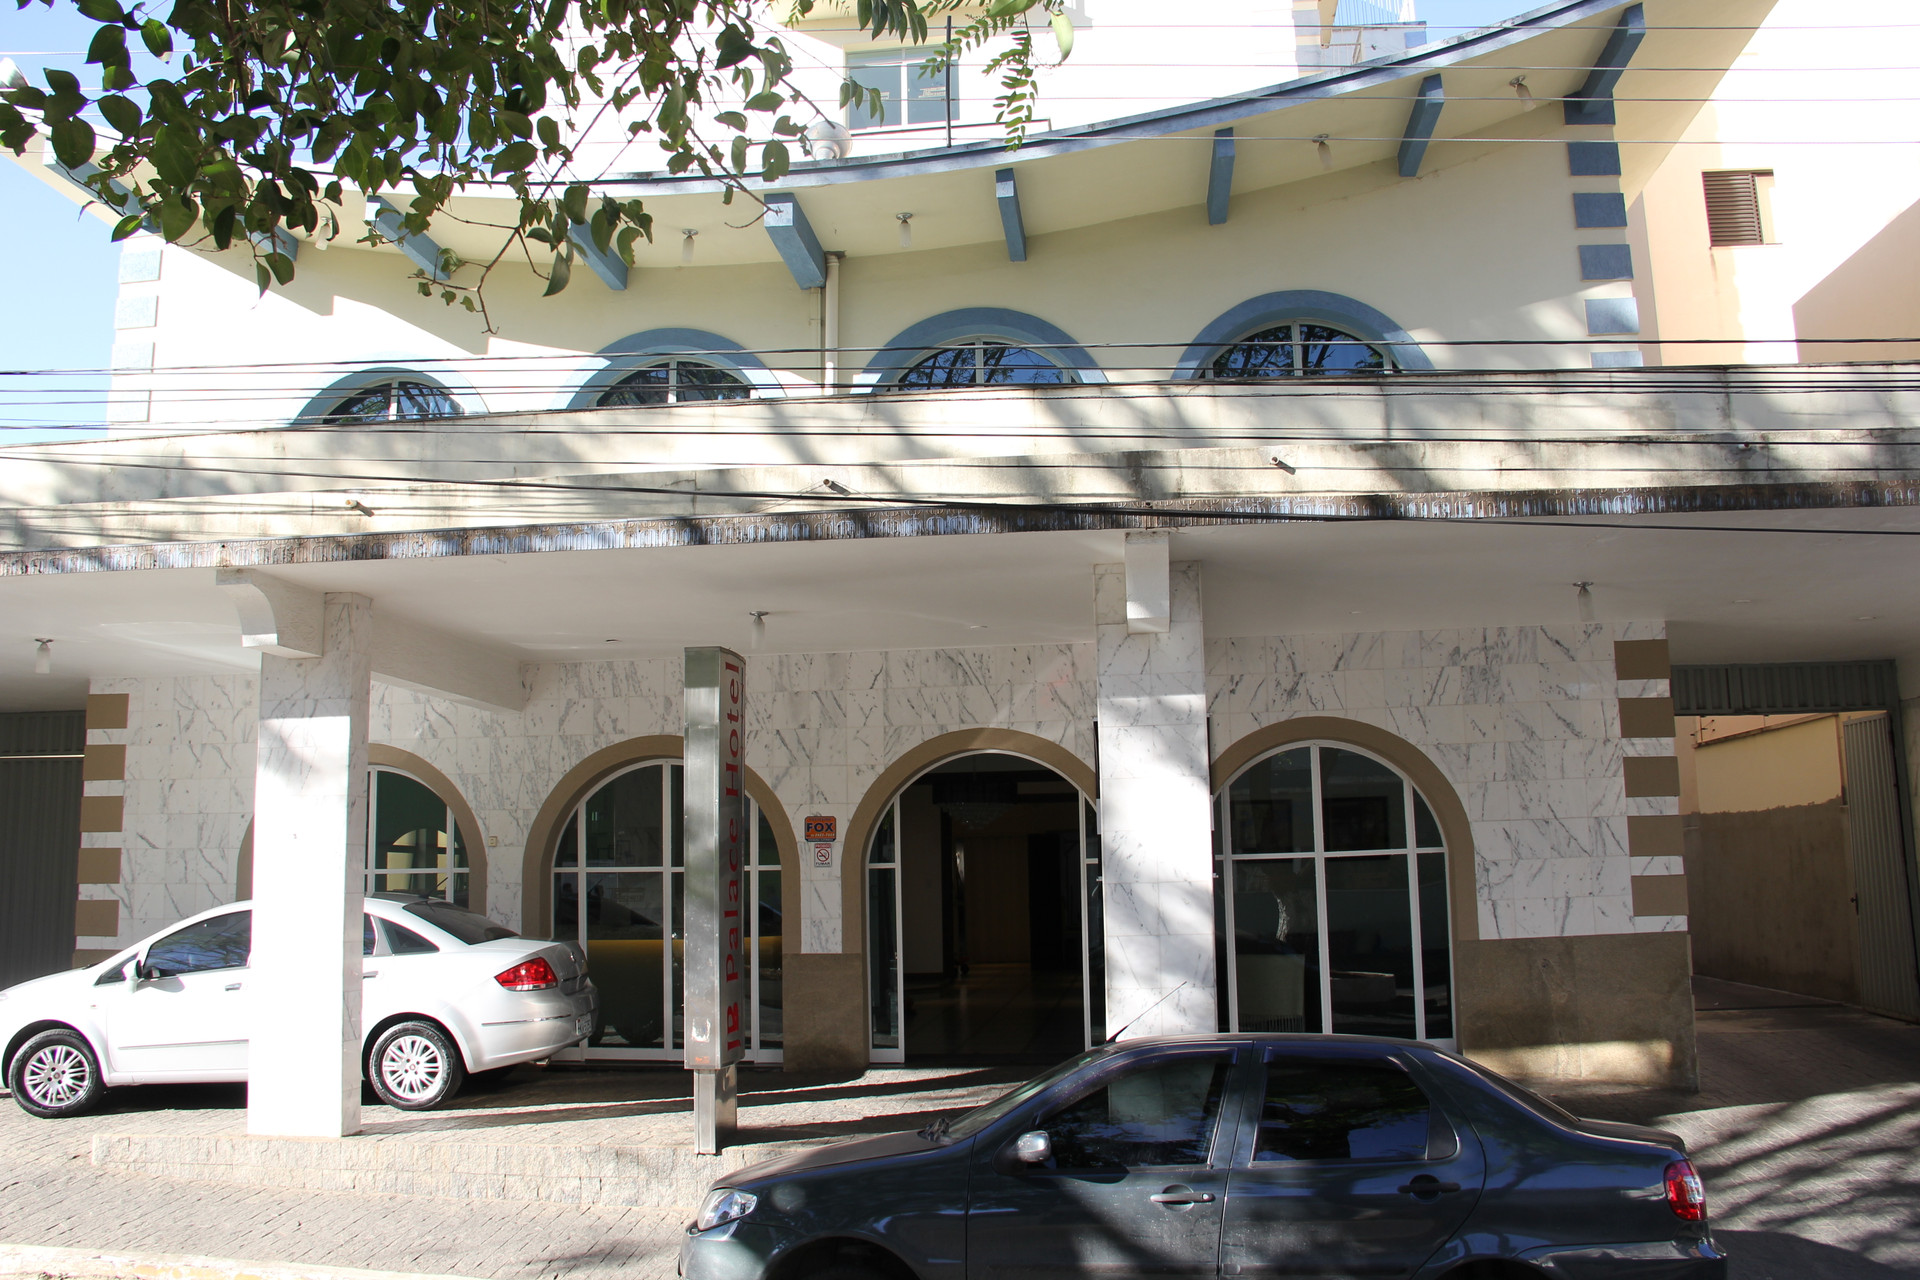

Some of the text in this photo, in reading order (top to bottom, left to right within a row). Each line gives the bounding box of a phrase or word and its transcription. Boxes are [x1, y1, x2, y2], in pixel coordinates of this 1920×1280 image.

[725, 662, 740, 797] Hotel
[807, 823, 833, 832] FOX
[724, 818, 739, 982] Palace
